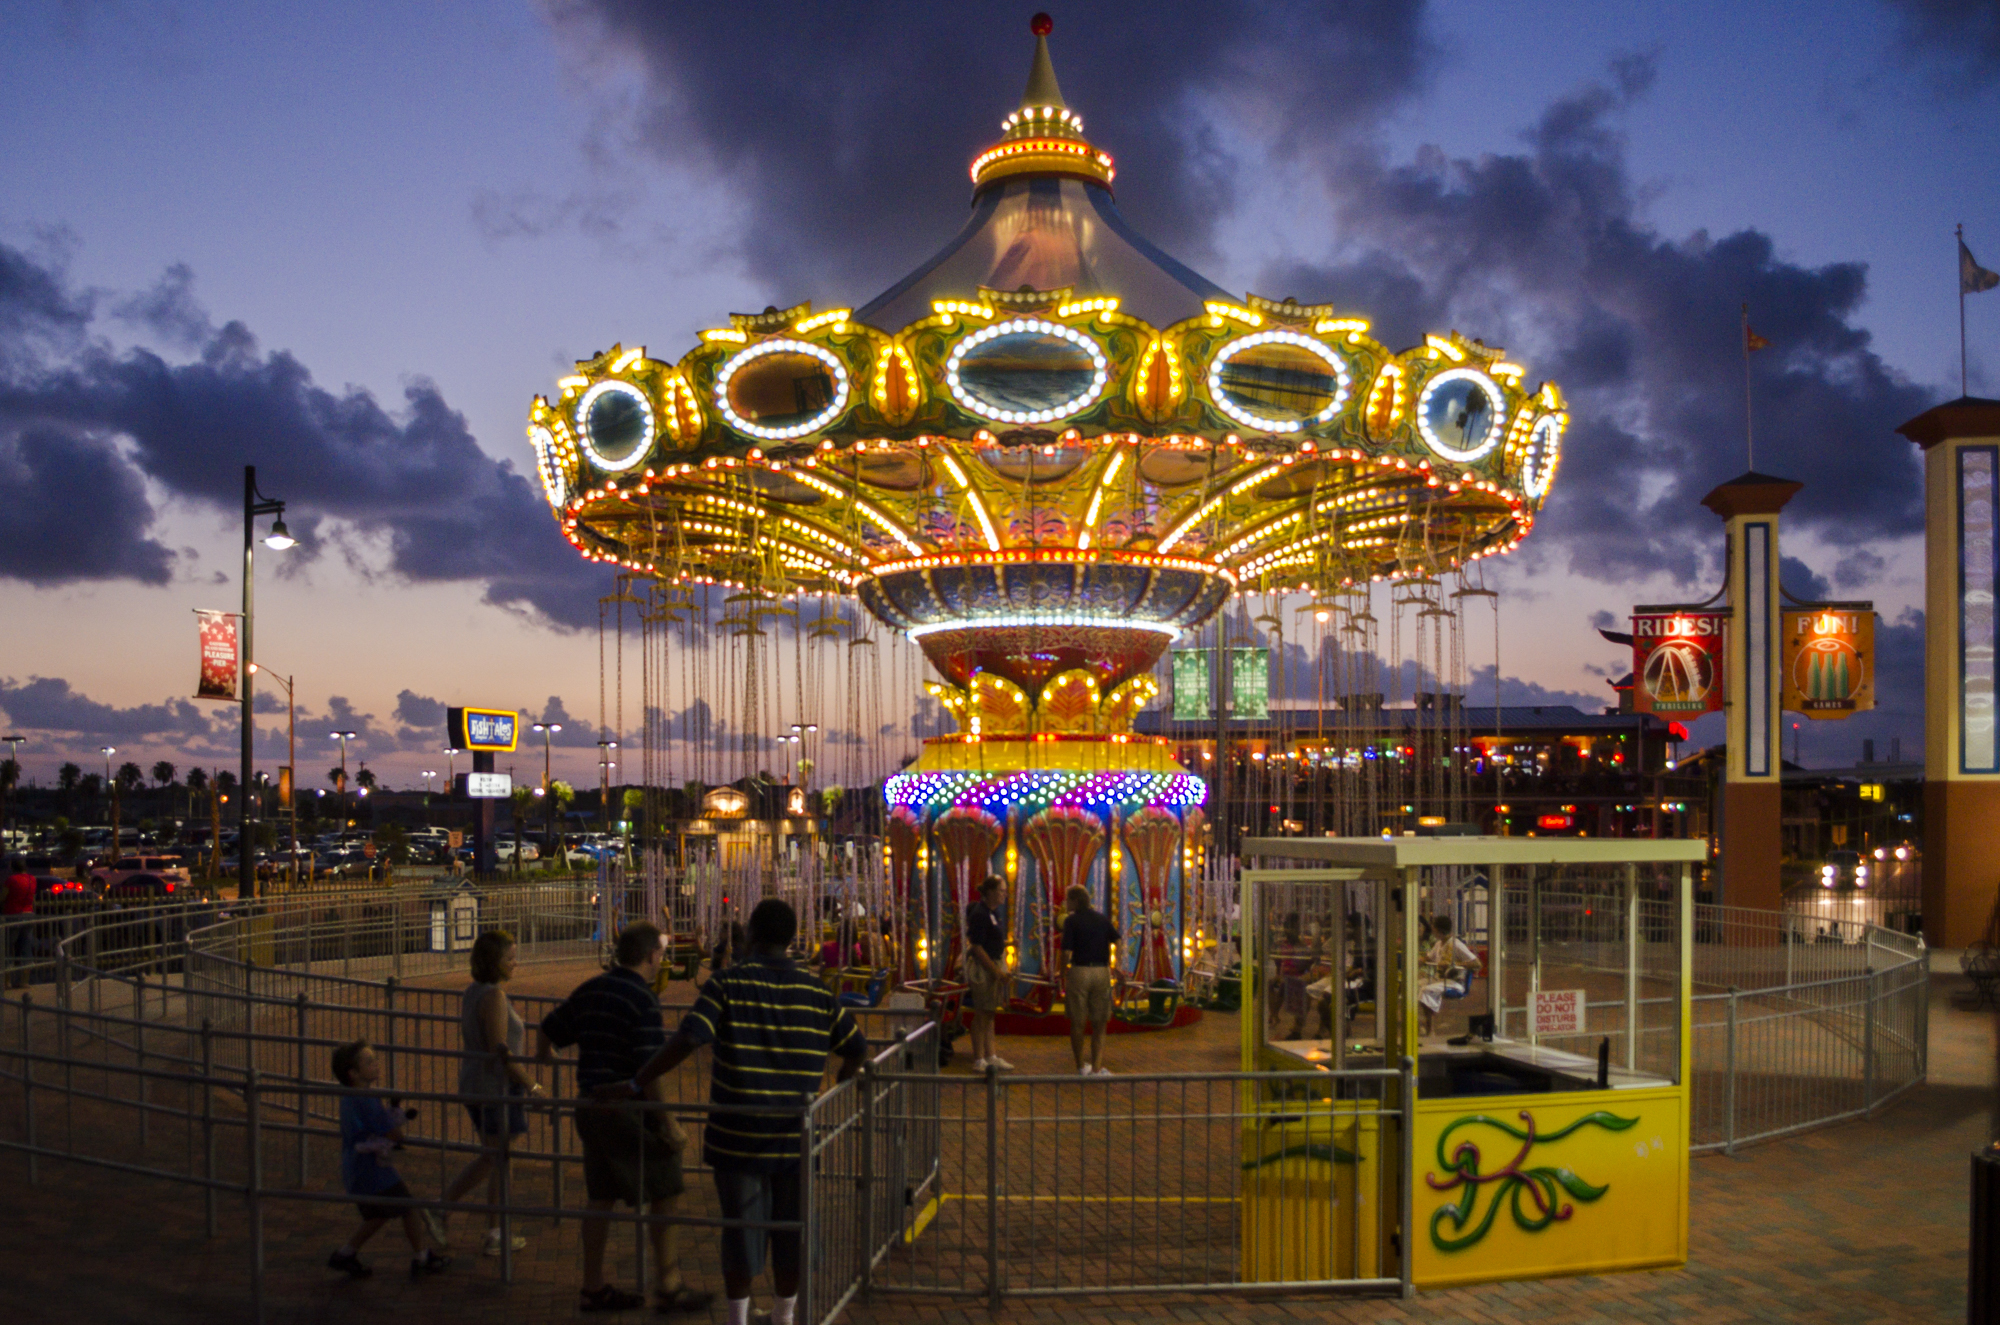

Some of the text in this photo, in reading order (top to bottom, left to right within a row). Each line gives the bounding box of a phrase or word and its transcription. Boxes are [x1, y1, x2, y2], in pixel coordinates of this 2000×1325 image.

[1637, 618, 1722, 636] RIDES!
[1797, 615, 1859, 634] FUN!
[204, 650, 234, 660] PLEASURE
[1655, 701, 1703, 711] THRILLING
[1812, 701, 1843, 710] GAMES
[1536, 992, 1576, 1002] PLEASE
[1536, 1003, 1576, 1014] DO NOT
[1536, 1014, 1577, 1024] DISTURB
[1536, 1024, 1577, 1032] OPERATOR
